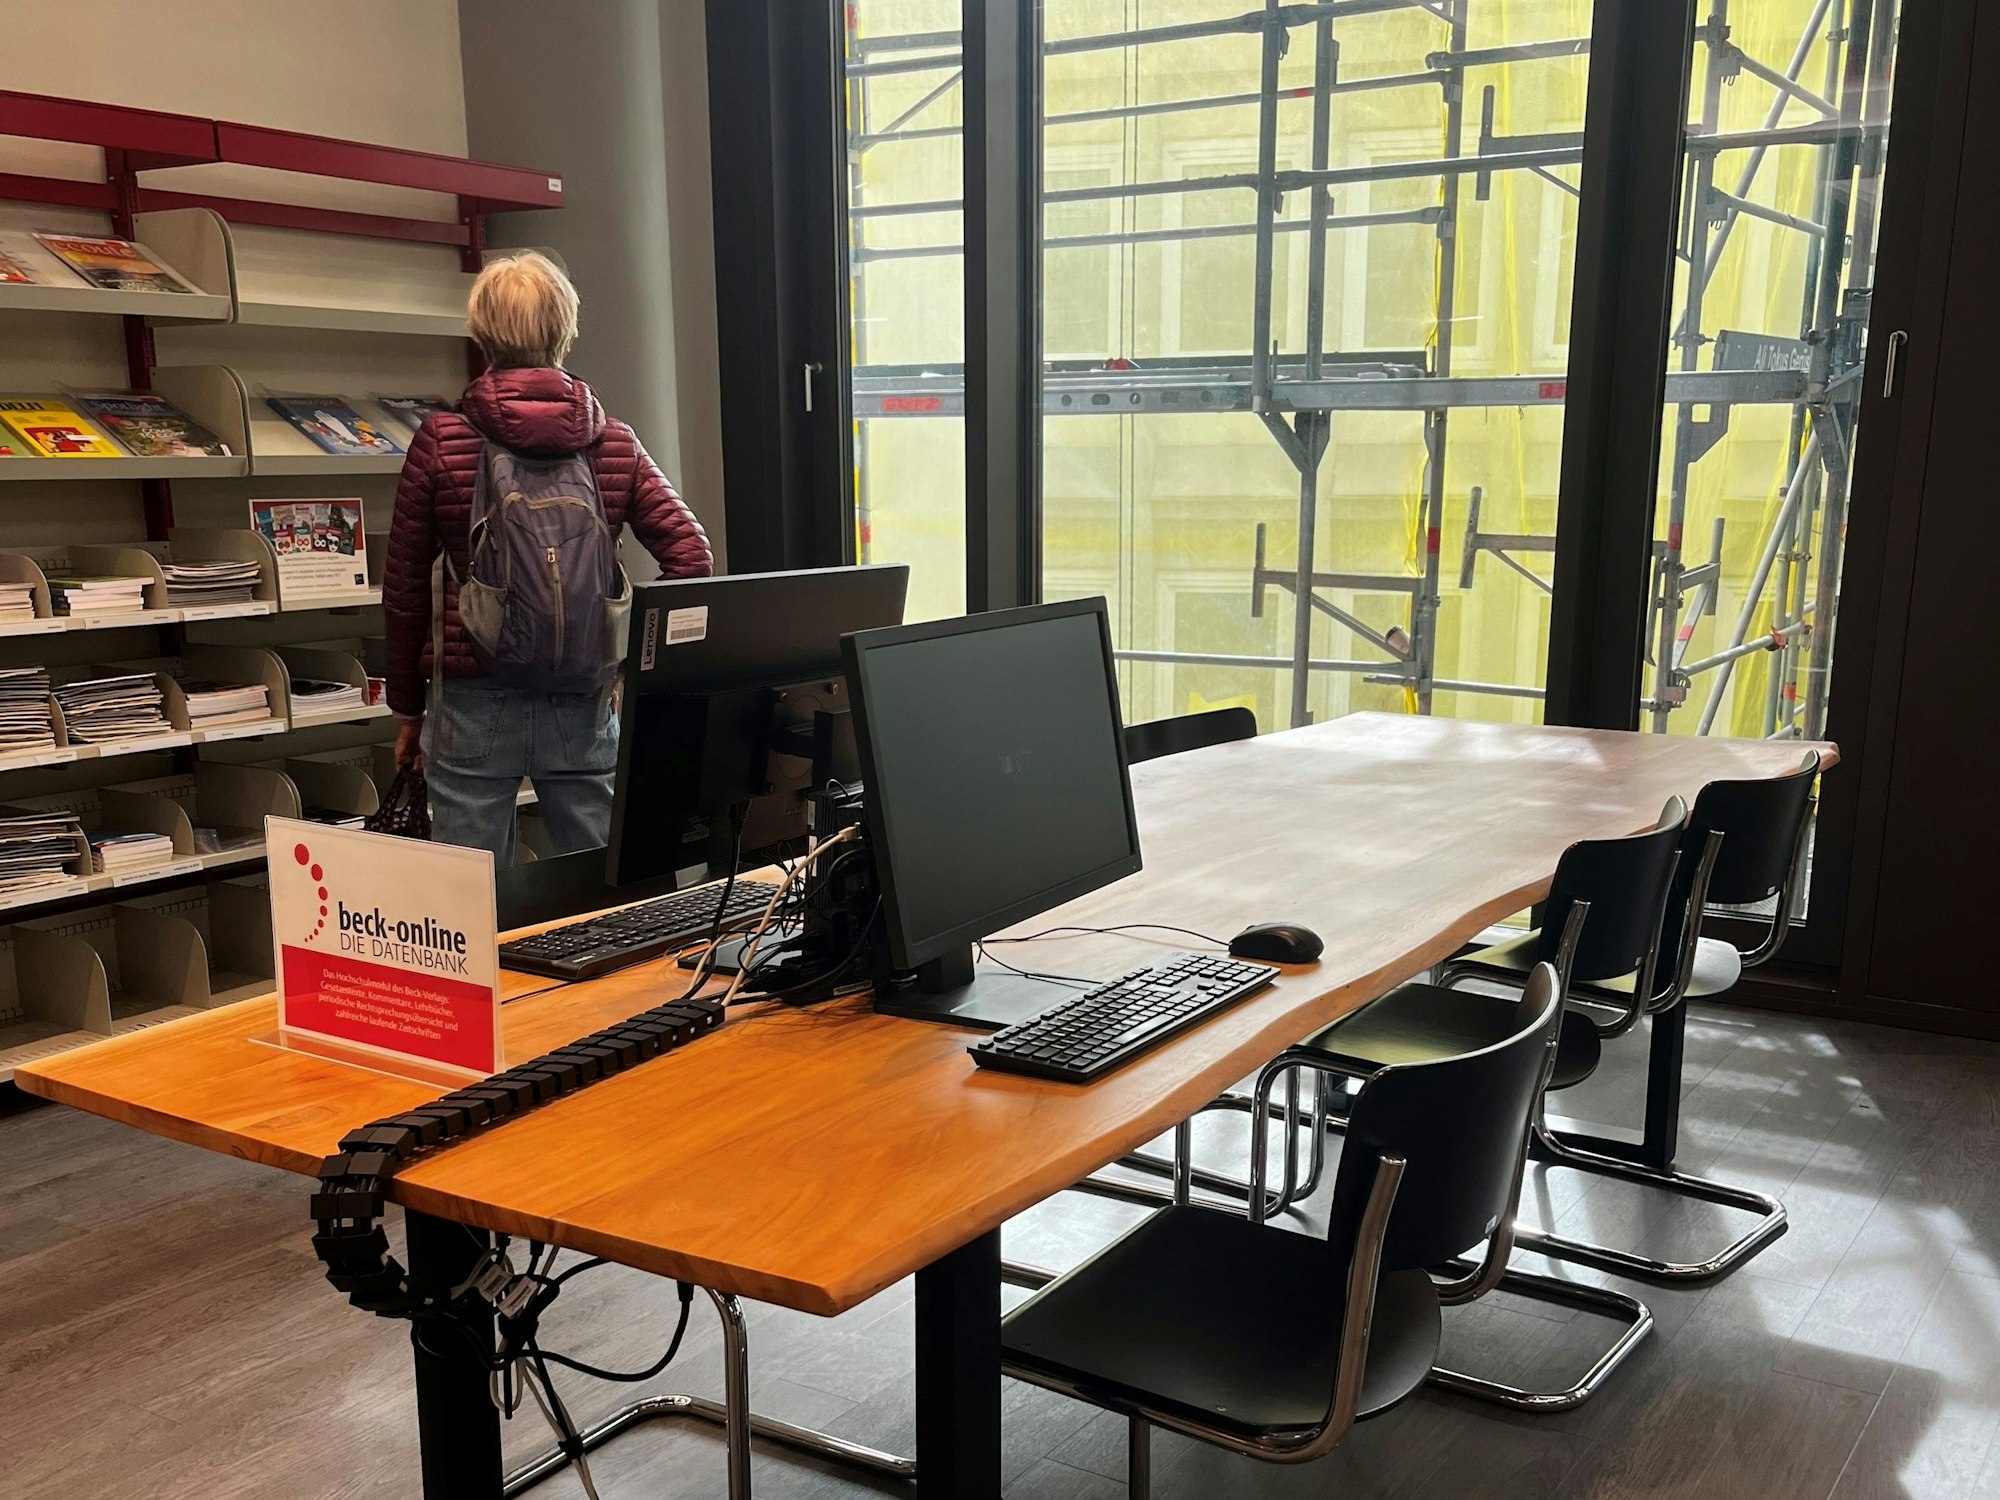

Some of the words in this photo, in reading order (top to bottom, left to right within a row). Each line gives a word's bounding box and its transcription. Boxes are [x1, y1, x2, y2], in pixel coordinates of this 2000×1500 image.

[90, 400, 167, 414] Spotlight
[644, 613, 656, 665] Lenovo
[338, 901, 466, 954] beck-online
[340, 933, 365, 954] DIE
[372, 939, 469, 975] DATENBANK
[323, 968, 335, 980] Das
[336, 970, 391, 992] Hochschulmodul
[392, 982, 404, 994] des
[318, 994, 356, 1009] periodische
[445, 1022, 459, 1032] und
[368, 991, 414, 1009] Kommentare,
[335, 1010, 368, 1024] zahlreiche
[369, 1016, 397, 1030] laufende
[399, 1022, 441, 1040] Zeitschriften
